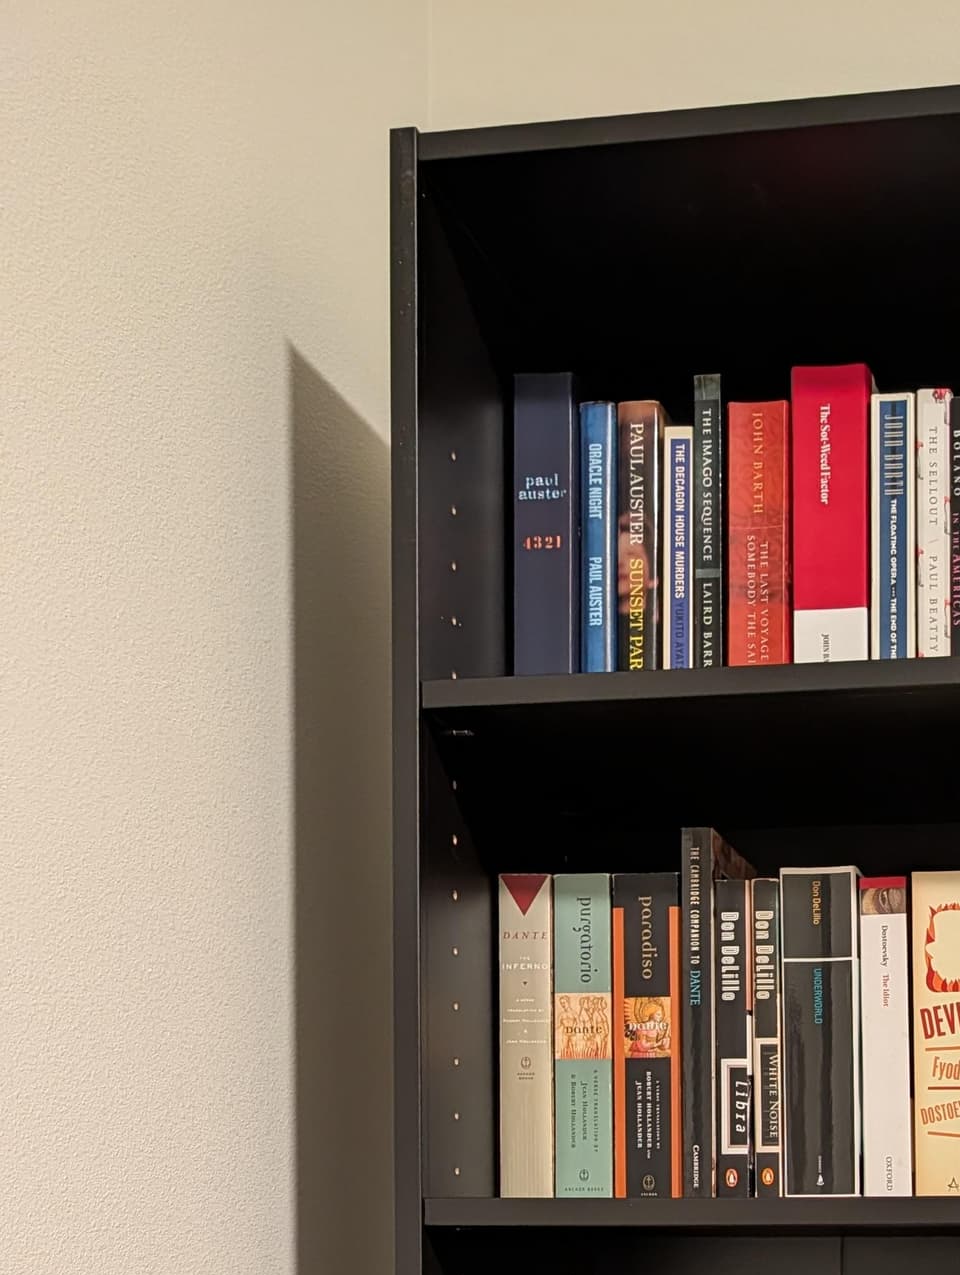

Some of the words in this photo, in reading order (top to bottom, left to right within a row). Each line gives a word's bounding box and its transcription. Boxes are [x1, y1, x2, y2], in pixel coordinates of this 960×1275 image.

[702, 408, 712, 435] THE
[928, 426, 937, 455] THE
[589, 443, 602, 485] ORACLE
[630, 422, 644, 471] PAUL
[675, 444, 686, 463] THE
[702, 438, 713, 488] IMAGO
[518, 487, 567, 500] auster
[525, 473, 559, 489] paul
[589, 487, 602, 519] NIGHT
[675, 466, 686, 512] DECAGON
[928, 460, 937, 527] SELLOUT
[630, 474, 644, 545] AUSTER
[675, 514, 686, 548] HOUSE
[702, 492, 713, 561] SEQUENCE
[589, 556, 602, 584] PAUL
[630, 559, 644, 625] SUNSET
[675, 551, 686, 599] MURDERS
[928, 555, 937, 592] PAUL
[589, 585, 603, 627] AUSTER
[702, 583, 713, 627] LAIRD
[928, 598, 938, 653] BEATTY
[503, 931, 547, 940] DANTE
[572, 897, 600, 984] purgatorio
[638, 896, 657, 980] paradiso
[813, 968, 822, 1025] UNDERWORLD
